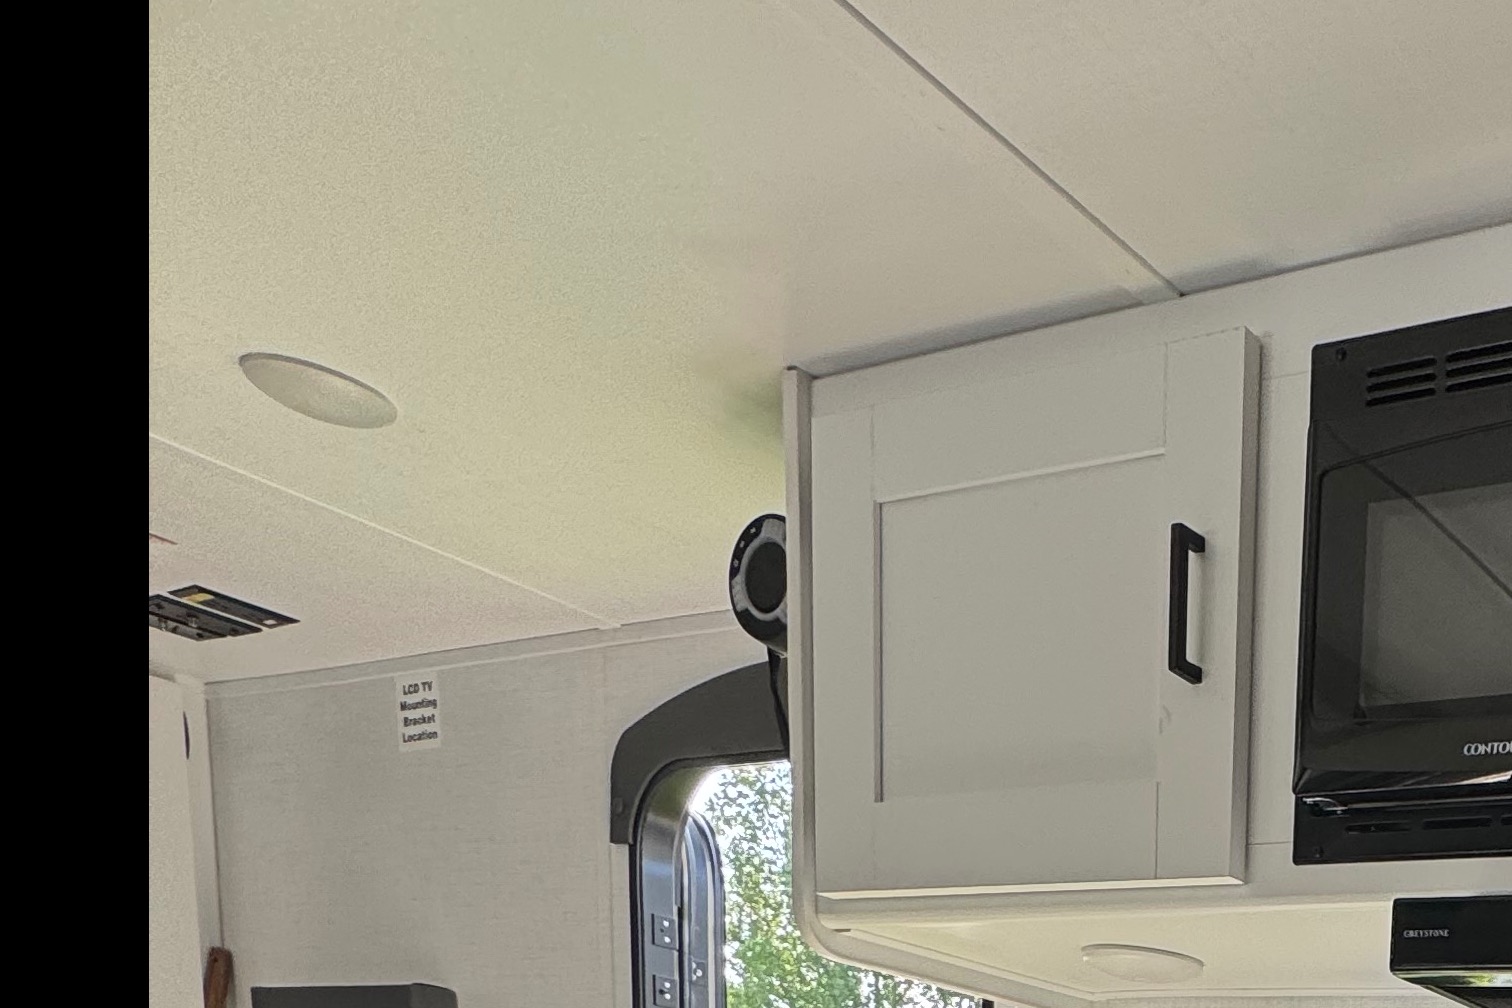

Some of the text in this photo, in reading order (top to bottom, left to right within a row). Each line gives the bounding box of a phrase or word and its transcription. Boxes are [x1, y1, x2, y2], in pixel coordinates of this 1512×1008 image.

[402, 680, 434, 695] LCD TV
[403, 713, 435, 727] Bracket
[402, 729, 438, 743] Location
